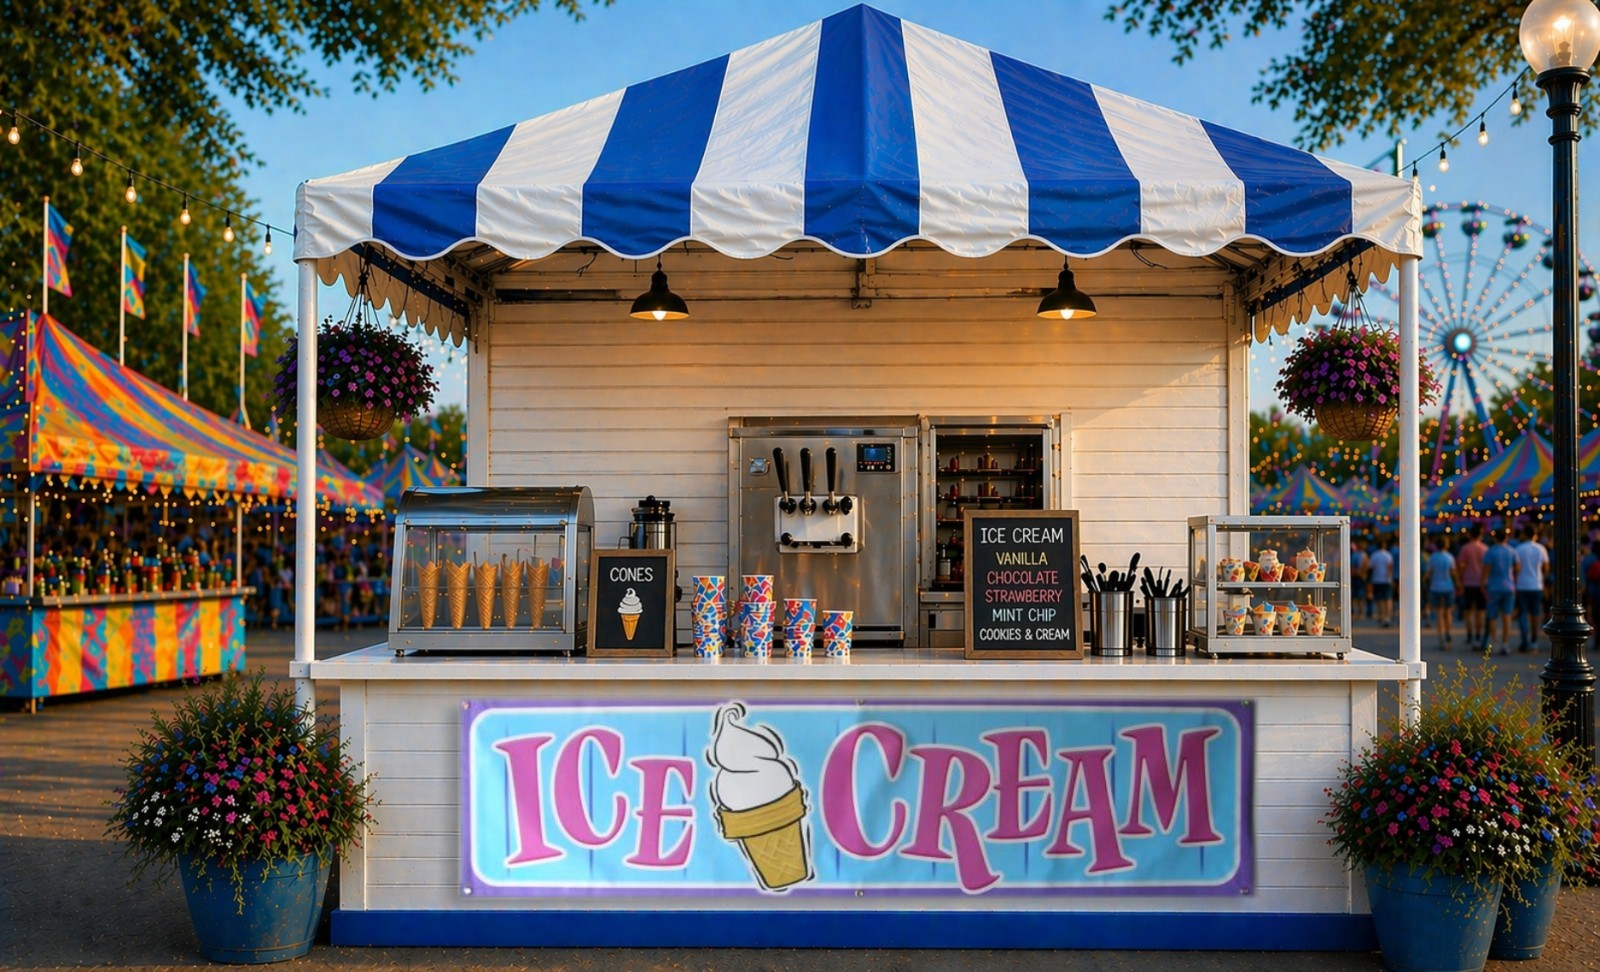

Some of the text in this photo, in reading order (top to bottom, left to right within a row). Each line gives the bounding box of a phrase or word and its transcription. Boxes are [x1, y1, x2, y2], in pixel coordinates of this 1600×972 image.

[981, 528, 1063, 544] ICE CREAM
[996, 552, 1048, 565] VANILLA
[610, 567, 653, 582] CONES
[987, 571, 1059, 585] CHOCOLATE
[985, 589, 1063, 603] STRAWBERRY
[992, 608, 1056, 622] MINT CHIP
[980, 628, 1070, 640] COOKIES & CREAM
[493, 723, 1224, 893] ICE CREAM
